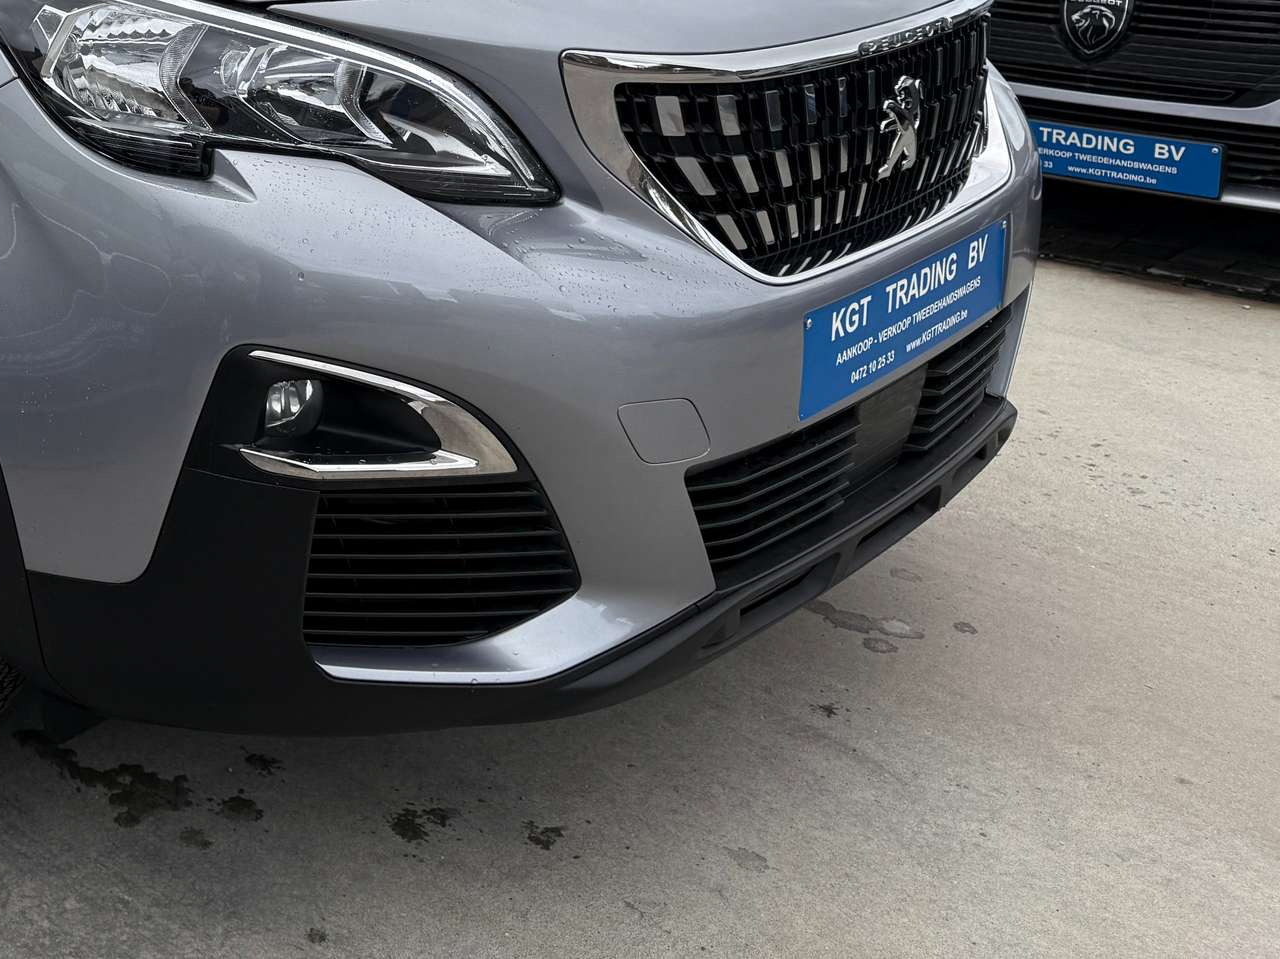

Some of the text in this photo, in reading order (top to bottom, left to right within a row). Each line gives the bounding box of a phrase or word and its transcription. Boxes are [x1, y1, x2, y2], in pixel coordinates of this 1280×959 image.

[1038, 147, 1178, 174] ERKOOP TWEEDEHANDSWAGENS
[1039, 127, 1186, 161] TRADING BV
[1067, 165, 1157, 184] www.KGTTRADING.be
[831, 234, 988, 342] KGT TRADING BV
[836, 338, 873, 366] AANKOOP
[878, 316, 912, 344] VERKOOP
[913, 276, 981, 325] TWEEDEHANDSWAGENS
[850, 309, 968, 384] 0472 10 25 33 www.KGTTRADING.be
